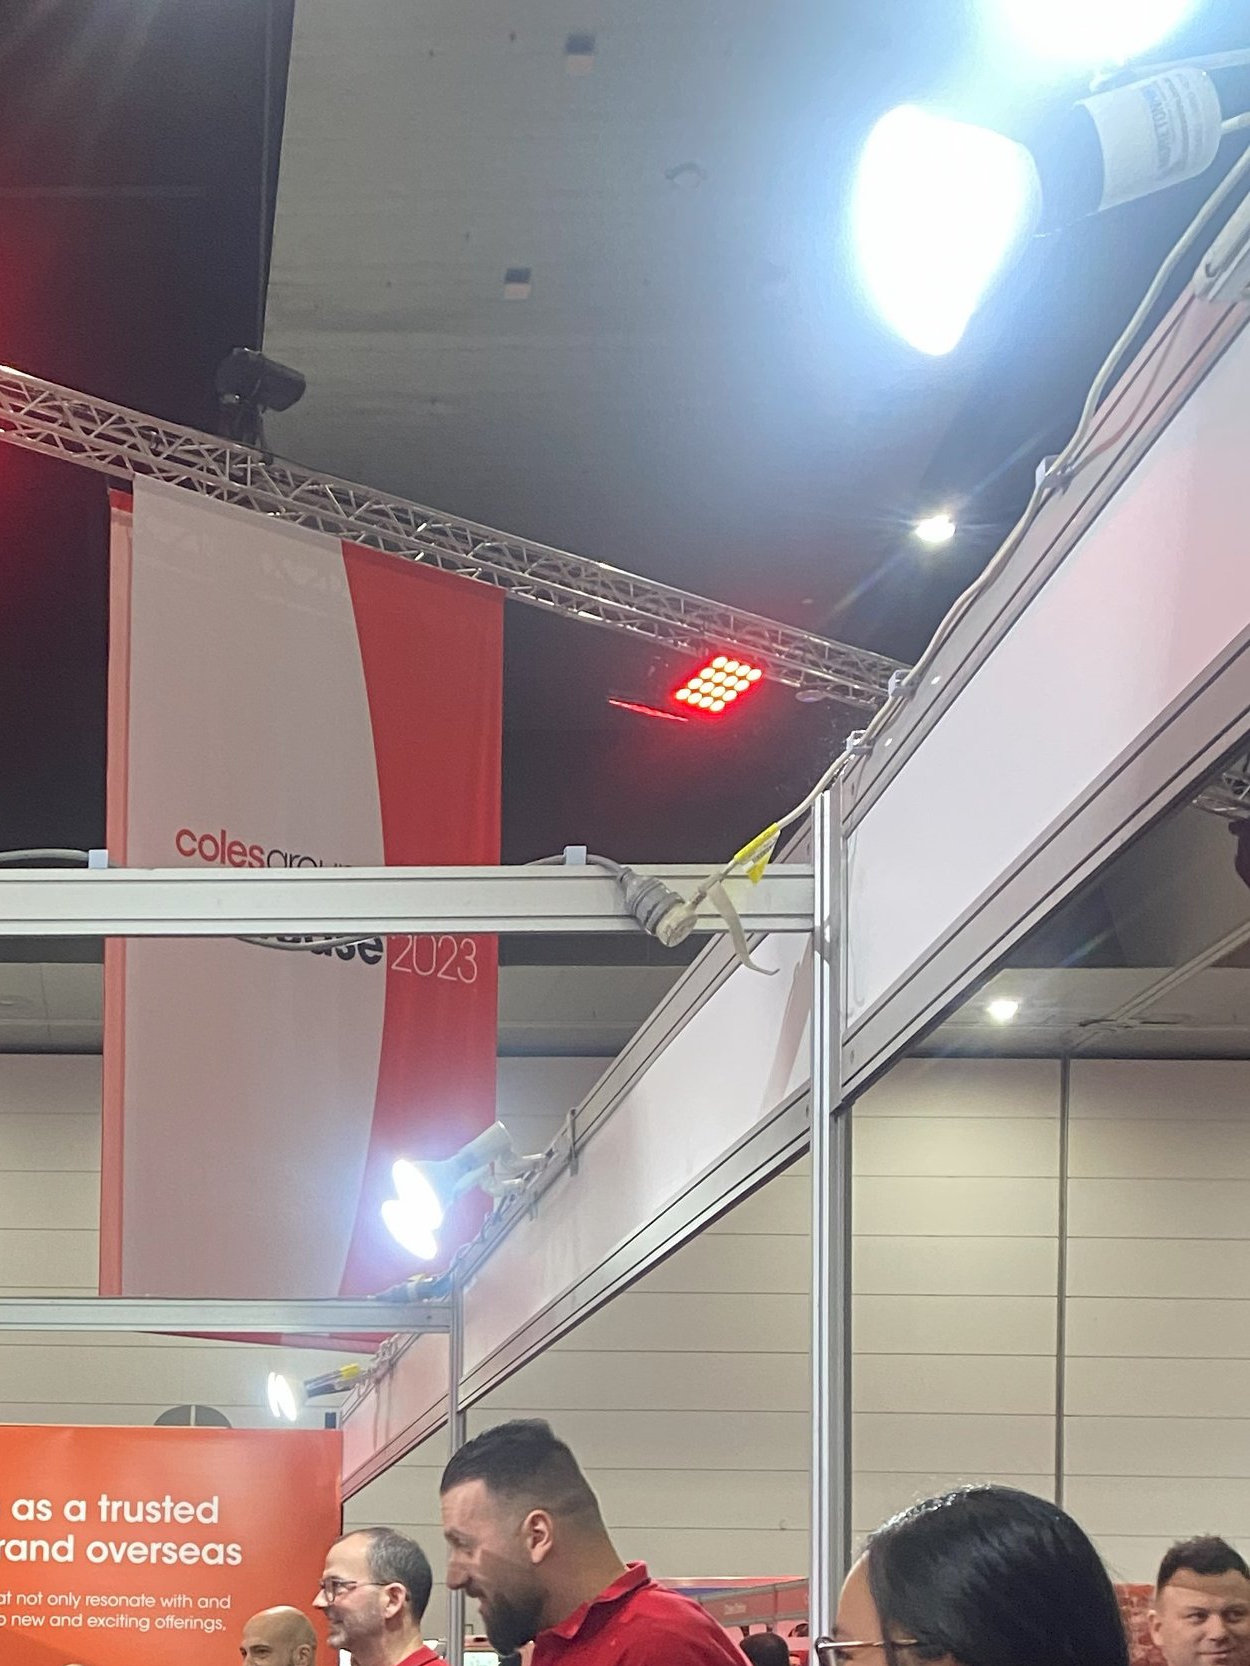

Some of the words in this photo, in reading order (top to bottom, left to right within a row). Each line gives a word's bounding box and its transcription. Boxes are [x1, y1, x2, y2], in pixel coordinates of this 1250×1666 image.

[391, 934, 478, 984] 2023
[11, 1498, 52, 1521] as
[63, 1498, 87, 1522] a
[98, 1494, 219, 1524] trusted
[86, 1541, 243, 1566] overseas
[16, 1591, 42, 1605] not
[47, 1592, 81, 1609] only
[86, 1594, 156, 1608] resonate
[160, 1594, 192, 1608] with
[197, 1595, 231, 1609] and
[11, 1614, 45, 1627] new
[49, 1613, 82, 1627] and
[87, 1613, 150, 1632] exciting
